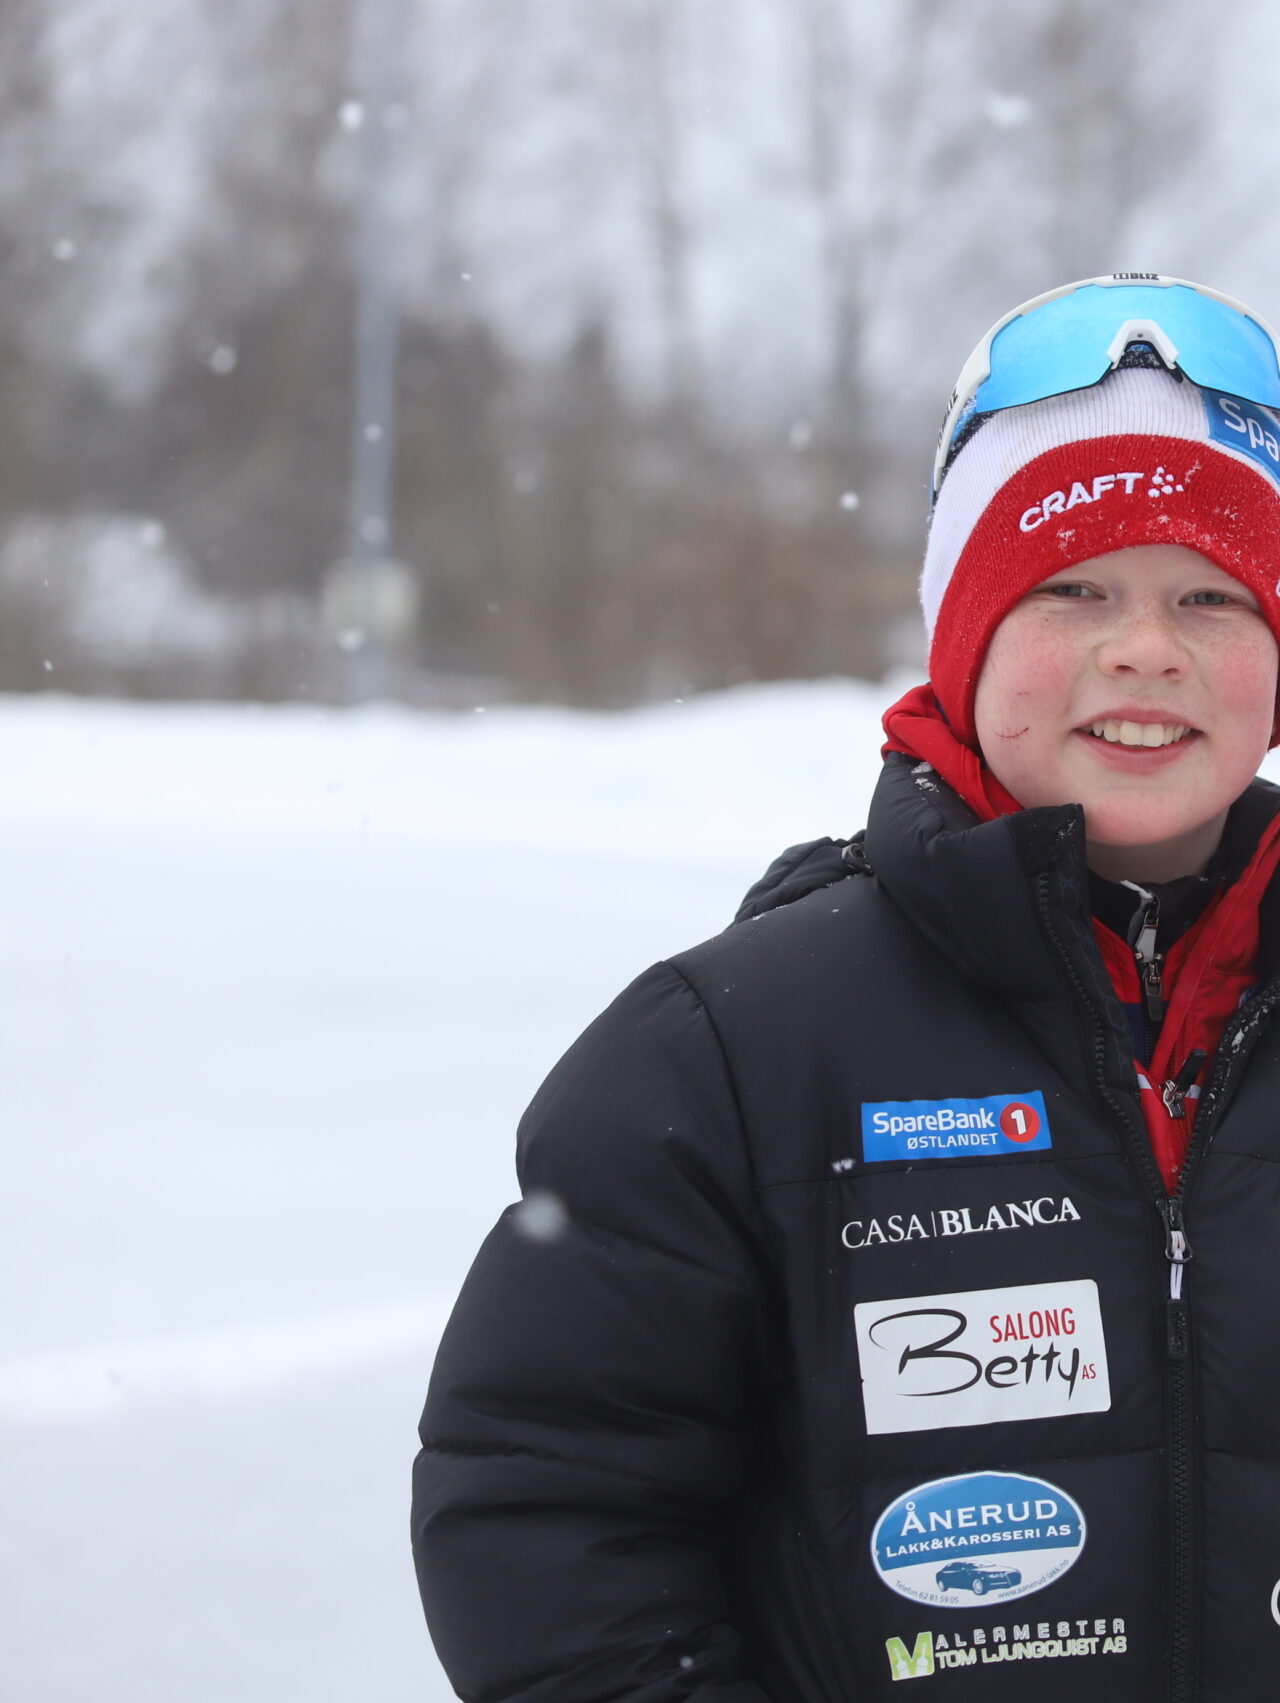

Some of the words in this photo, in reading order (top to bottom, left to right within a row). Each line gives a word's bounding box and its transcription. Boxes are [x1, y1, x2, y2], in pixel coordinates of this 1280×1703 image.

[1019, 471, 1144, 533] CRAFT
[873, 1108, 997, 1137] SpareBank
[1010, 1109, 1028, 1136] 1
[907, 1132, 999, 1151] ØSTLANDET
[989, 1307, 1077, 1344] SALONG
[869, 1308, 1080, 1402] Betty
[1081, 1363, 1097, 1381] AS
[900, 1499, 1059, 1537] ÅNERUD
[886, 1528, 1041, 1558] LAKK&KAROSSERI
[1046, 1524, 1072, 1537] AS
[896, 1579, 918, 1598] Telefon
[935, 1649, 977, 1670] TOM
[982, 1638, 1099, 1664] LJUNGQUIST
[1102, 1635, 1128, 1655] AS
